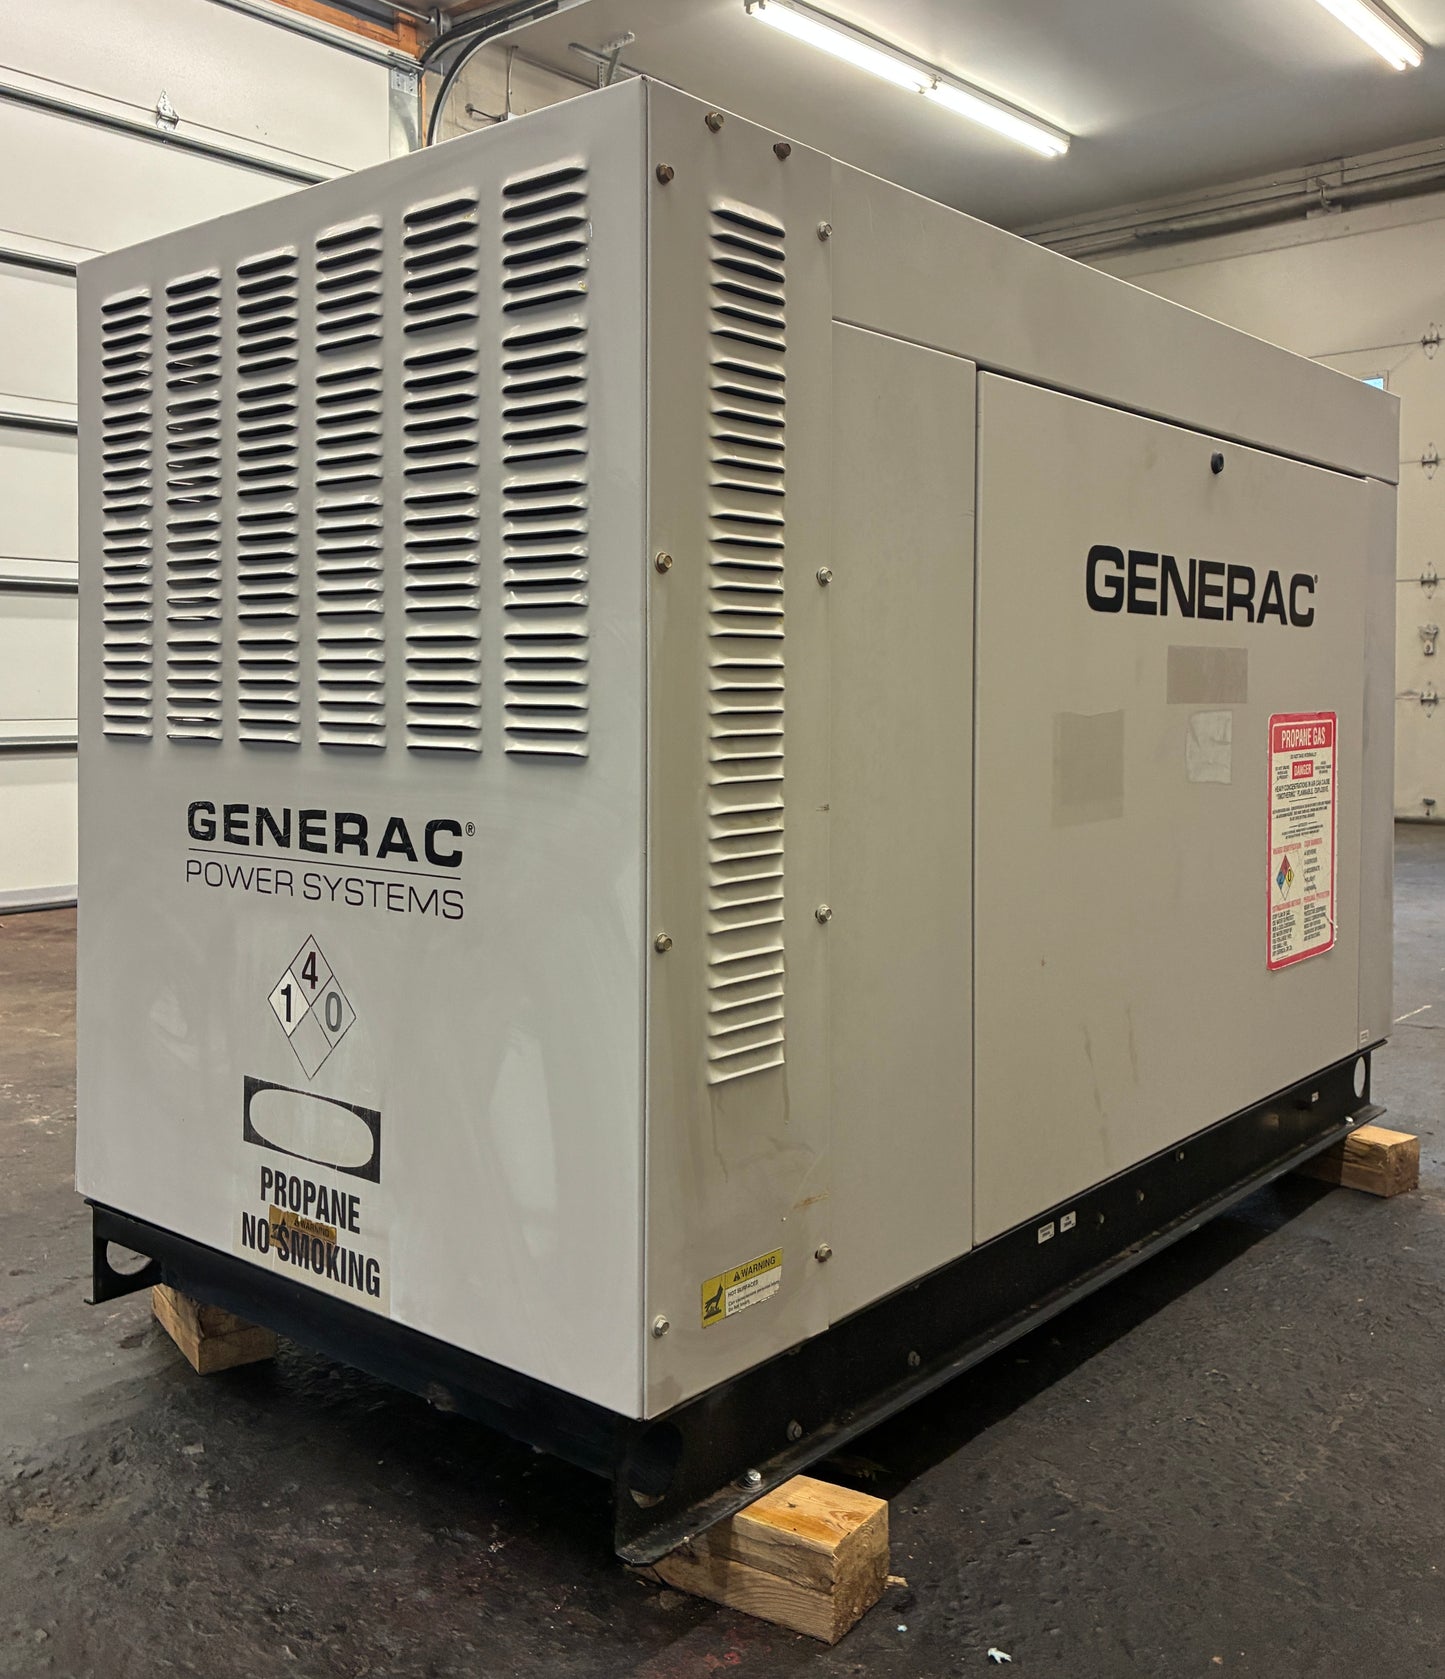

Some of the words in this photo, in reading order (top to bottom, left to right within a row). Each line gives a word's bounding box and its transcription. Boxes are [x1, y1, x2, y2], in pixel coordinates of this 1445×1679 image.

[1086, 544, 1315, 628] GENERAC
[1281, 728, 1311, 749] PROPANE
[1312, 726, 1326, 746] GAS
[1294, 763, 1312, 776] DANGER
[186, 859, 294, 897] POWER
[302, 873, 464, 920] SYSTEMS
[1287, 868, 1292, 882] 0
[301, 950, 319, 990] 4
[280, 983, 292, 1023] 1
[325, 991, 343, 1033] 0
[260, 1165, 361, 1235] PROPANE
[241, 1211, 270, 1254] NO
[277, 1224, 381, 1298] SMOKING
[740, 1255, 776, 1278] WARNING
